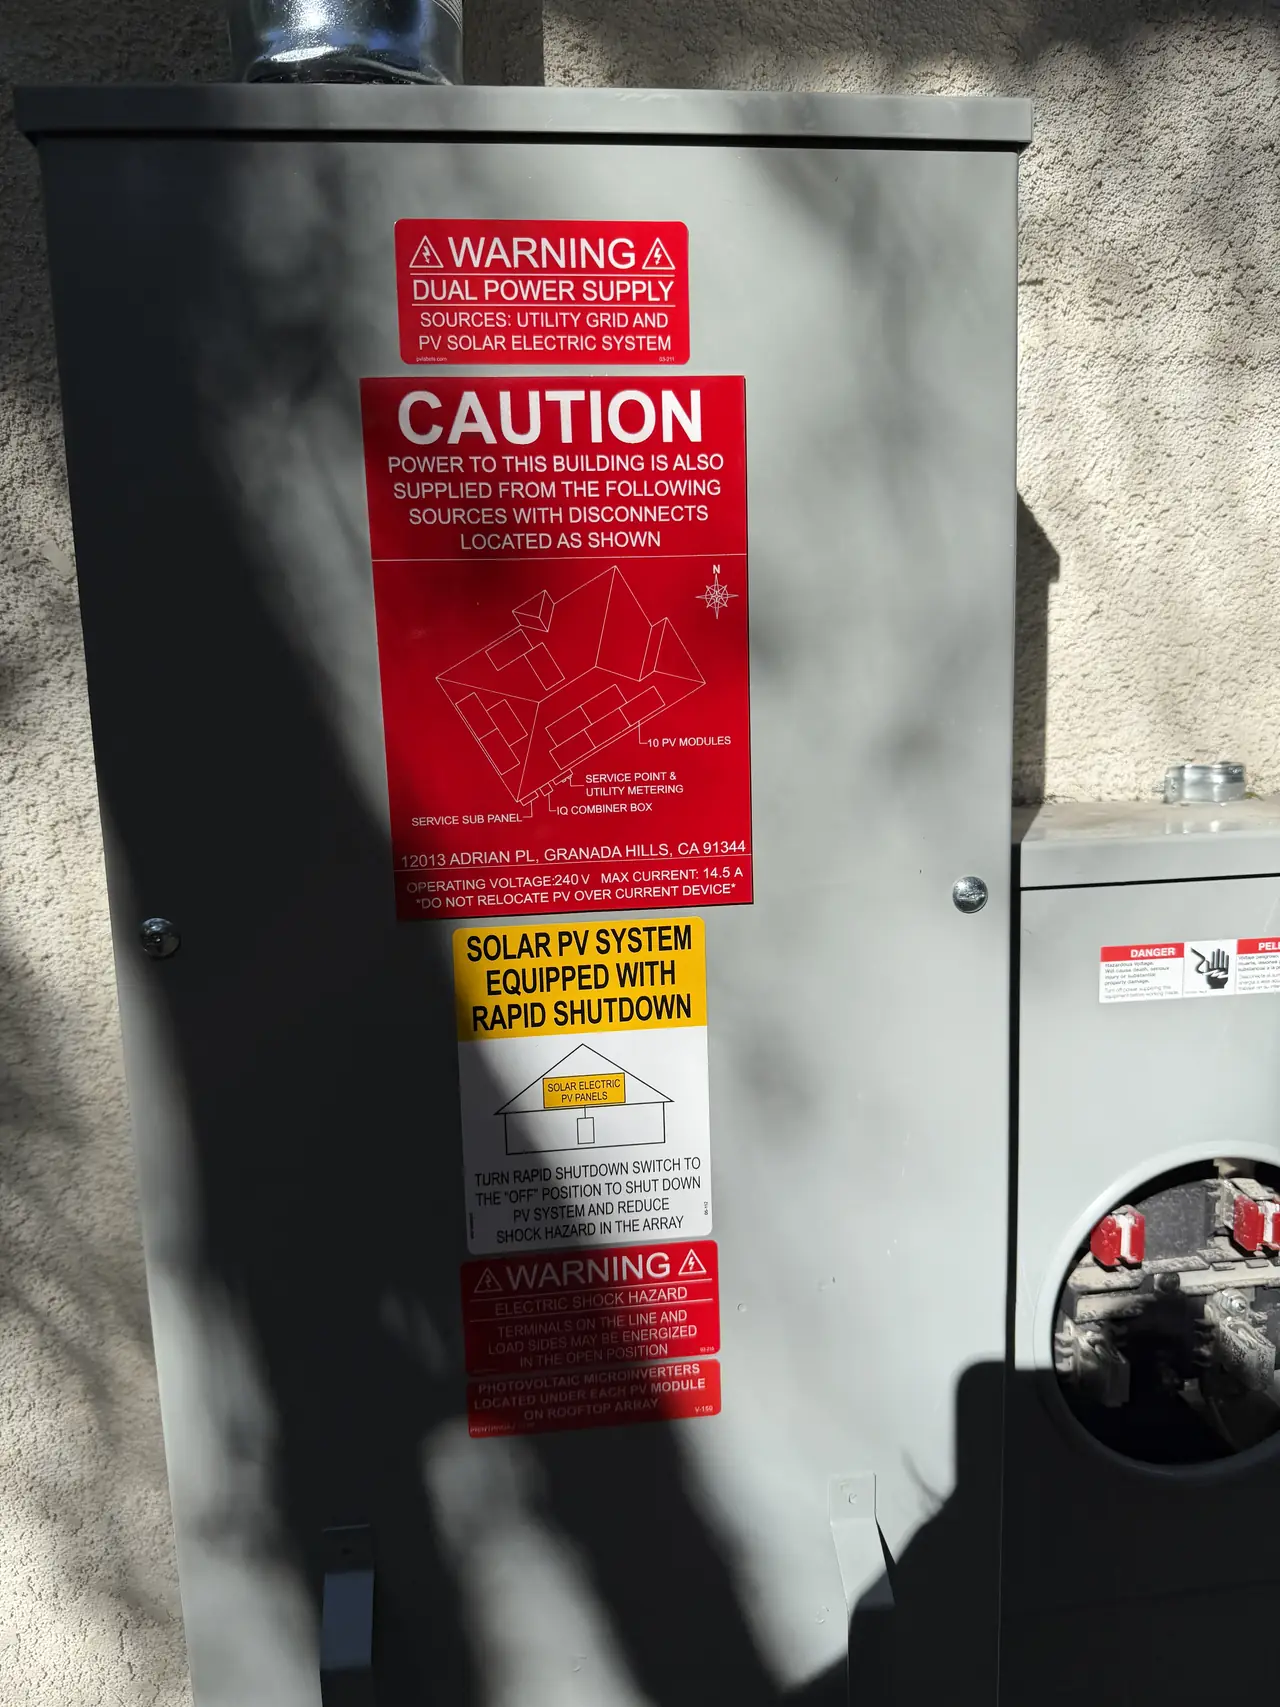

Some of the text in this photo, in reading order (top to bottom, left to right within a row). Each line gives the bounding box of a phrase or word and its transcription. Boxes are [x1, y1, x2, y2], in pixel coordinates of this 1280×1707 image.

[448, 237, 635, 269] WARNING
[414, 280, 674, 302] DUAL POWER SUPPLY
[420, 312, 668, 328] SOURCES: UTILITY GRID AND
[419, 336, 671, 351] PV SOLAR ELECTRIC SYSTEM
[397, 389, 702, 445] CAUTION
[388, 454, 724, 473] POWER TO THIS BUILDING IS ALSO
[393, 480, 721, 499] SUPPLIED FROM THE FOLLOWING
[409, 505, 708, 525] SOURCES WITH DISCONNECTS
[461, 531, 661, 550] LOCATED AS SHOWN
[713, 565, 720, 573] N
[648, 736, 731, 748] 10 PV MODULES
[585, 772, 676, 784] SERVICE POINT &
[586, 784, 683, 798] UTILITY METERING
[412, 813, 522, 826] SERVICE SUB PANEL
[557, 803, 652, 816] IQ COMBINER BOX
[401, 840, 745, 869] 12013 ADRIAN PL, GRANADA HILLS, CA 91344
[407, 879, 486, 894] OPERATING
[580, 873, 590, 885] V
[602, 872, 629, 884] MAX
[632, 869, 698, 883] CURRENT:
[703, 867, 730, 880] 14.5
[733, 866, 743, 878] A
[446, 894, 474, 908] NOT
[478, 892, 548, 906] RELOCATE
[553, 890, 570, 904] PV
[575, 888, 612, 903] OVER
[616, 885, 678, 901] CURRENT
[467, 925, 691, 962] SOLAR PV SYSTEM
[1130, 948, 1176, 958] DANGER
[487, 960, 675, 996] EQUIPPED WITH
[473, 993, 691, 1031] RAPID SHUTDOWN
[547, 1079, 620, 1093] SOLAR ELECTRIC
[561, 1092, 608, 1103] PV PANELS
[475, 1157, 701, 1187] TURN RAPID SHUTDOWN SWITCH TO
[476, 1176, 701, 1206] THE "OFF" POSITION TO SHUT DOWN
[513, 1198, 669, 1222] PV SYSTEM AND REDUCE
[497, 1216, 684, 1244] SHOCK HAZARD IN THE ARRAY
[506, 1252, 670, 1291] WARNING
[495, 1287, 688, 1316] ELECTRIC SHOCK HAZARD
[498, 1310, 687, 1338] TERMINALS ON THE LINE AND
[488, 1325, 697, 1355] LOAD SIDES MAY BE ENERGIZED
[520, 1344, 668, 1367] IN THE OPEN POSITION
[478, 1364, 700, 1394] PHOTOVOLTAIC MICROINVERTERS
[474, 1378, 706, 1411] LOCATED UNDER EACH PV MODULE
[524, 1397, 660, 1420] ON ROOFTOP ARRAY
